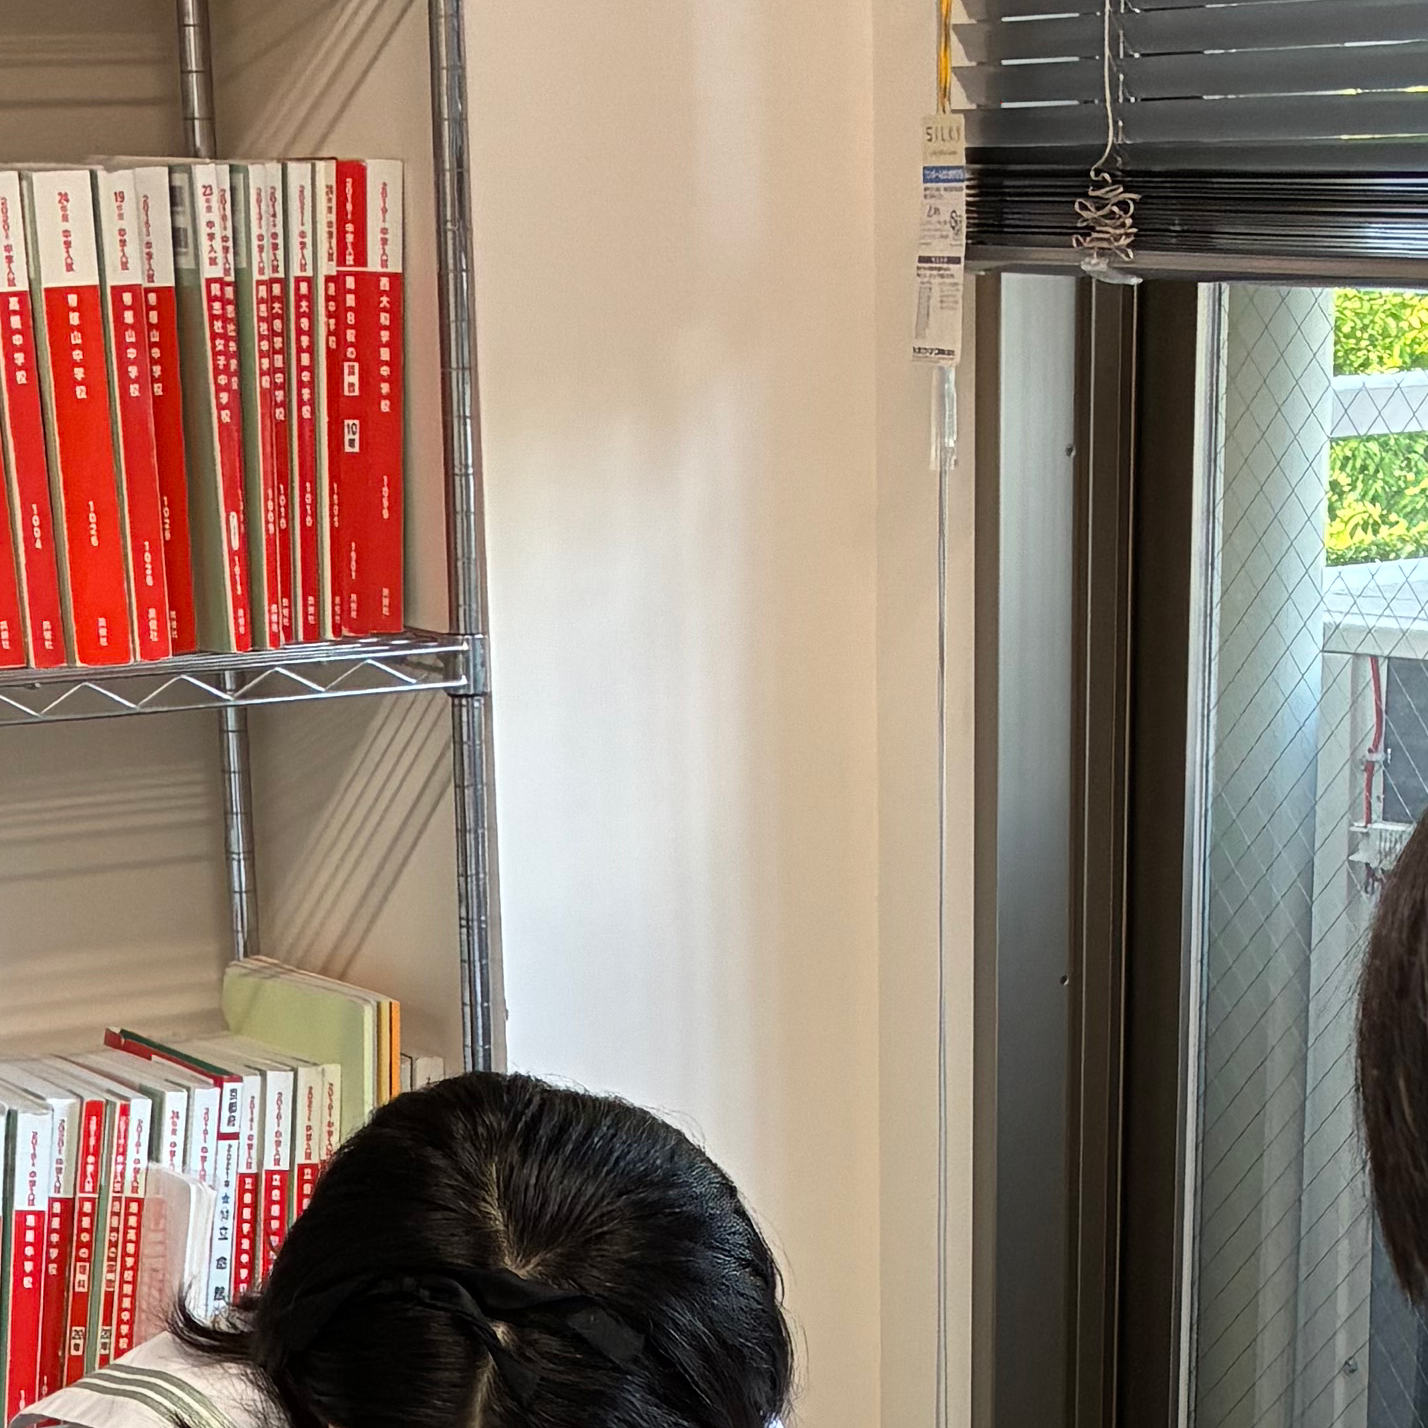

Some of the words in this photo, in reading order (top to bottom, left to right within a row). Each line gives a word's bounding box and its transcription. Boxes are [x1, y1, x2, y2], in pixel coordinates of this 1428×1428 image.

[62, 230, 76, 272] 中学入試
[118, 228, 130, 270] 中学入試
[145, 241, 156, 283] 中学入試
[206, 220, 218, 266] 中学入試
[257, 234, 266, 276] 中学入試
[271, 232, 280, 274] 中学入試
[298, 230, 308, 272] 中学入試
[345, 223, 354, 265] 中学入試
[380, 226, 390, 269] 中学入試
[4, 244, 17, 287] 中学入試
[32, 504, 42, 549] 1004
[246, 1134, 254, 1170] 中学入試
[274, 1131, 282, 1166] 中学入試
[304, 1125, 312, 1160] 中学入試
[27, 1171, 36, 1207] 中学入試
[54, 1158, 64, 1194] 中学入試
[85, 1155, 95, 1192] 中学入試
[131, 1158, 140, 1195] 中学入試
